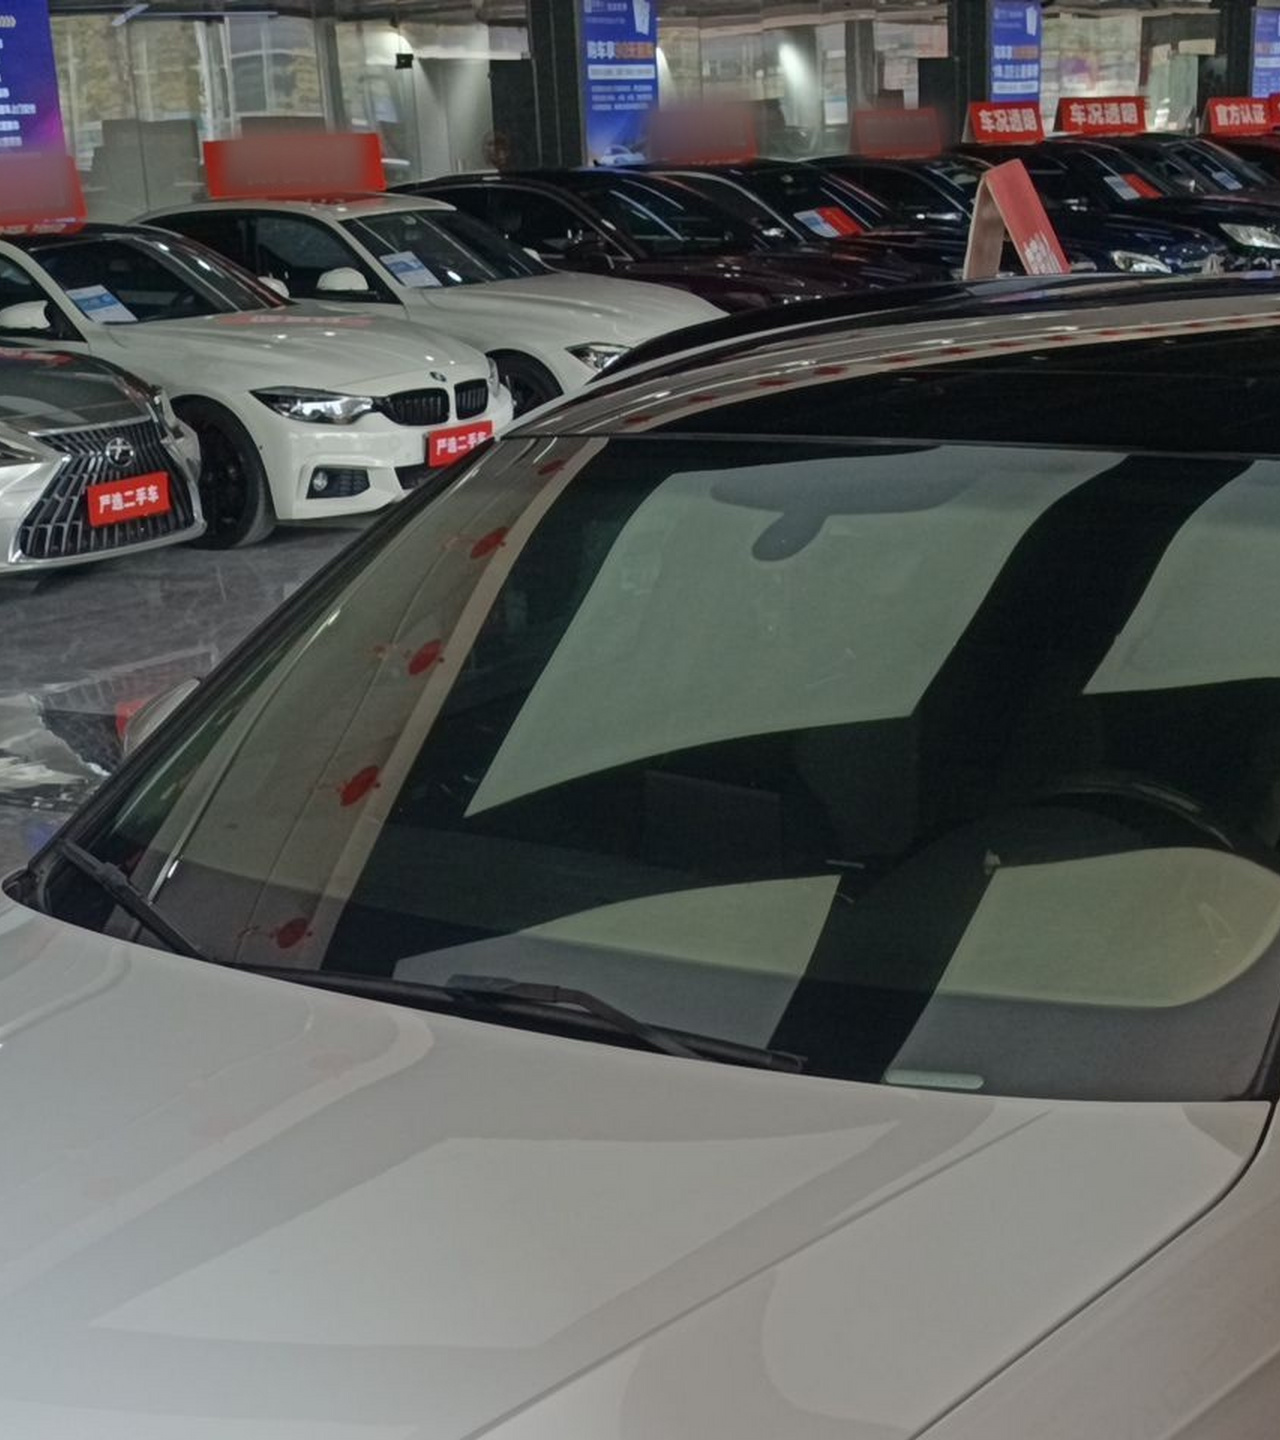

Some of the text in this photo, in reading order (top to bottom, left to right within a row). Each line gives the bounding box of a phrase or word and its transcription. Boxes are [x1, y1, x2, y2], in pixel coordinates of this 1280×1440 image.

[98, 485, 160, 514] 严选二手车
